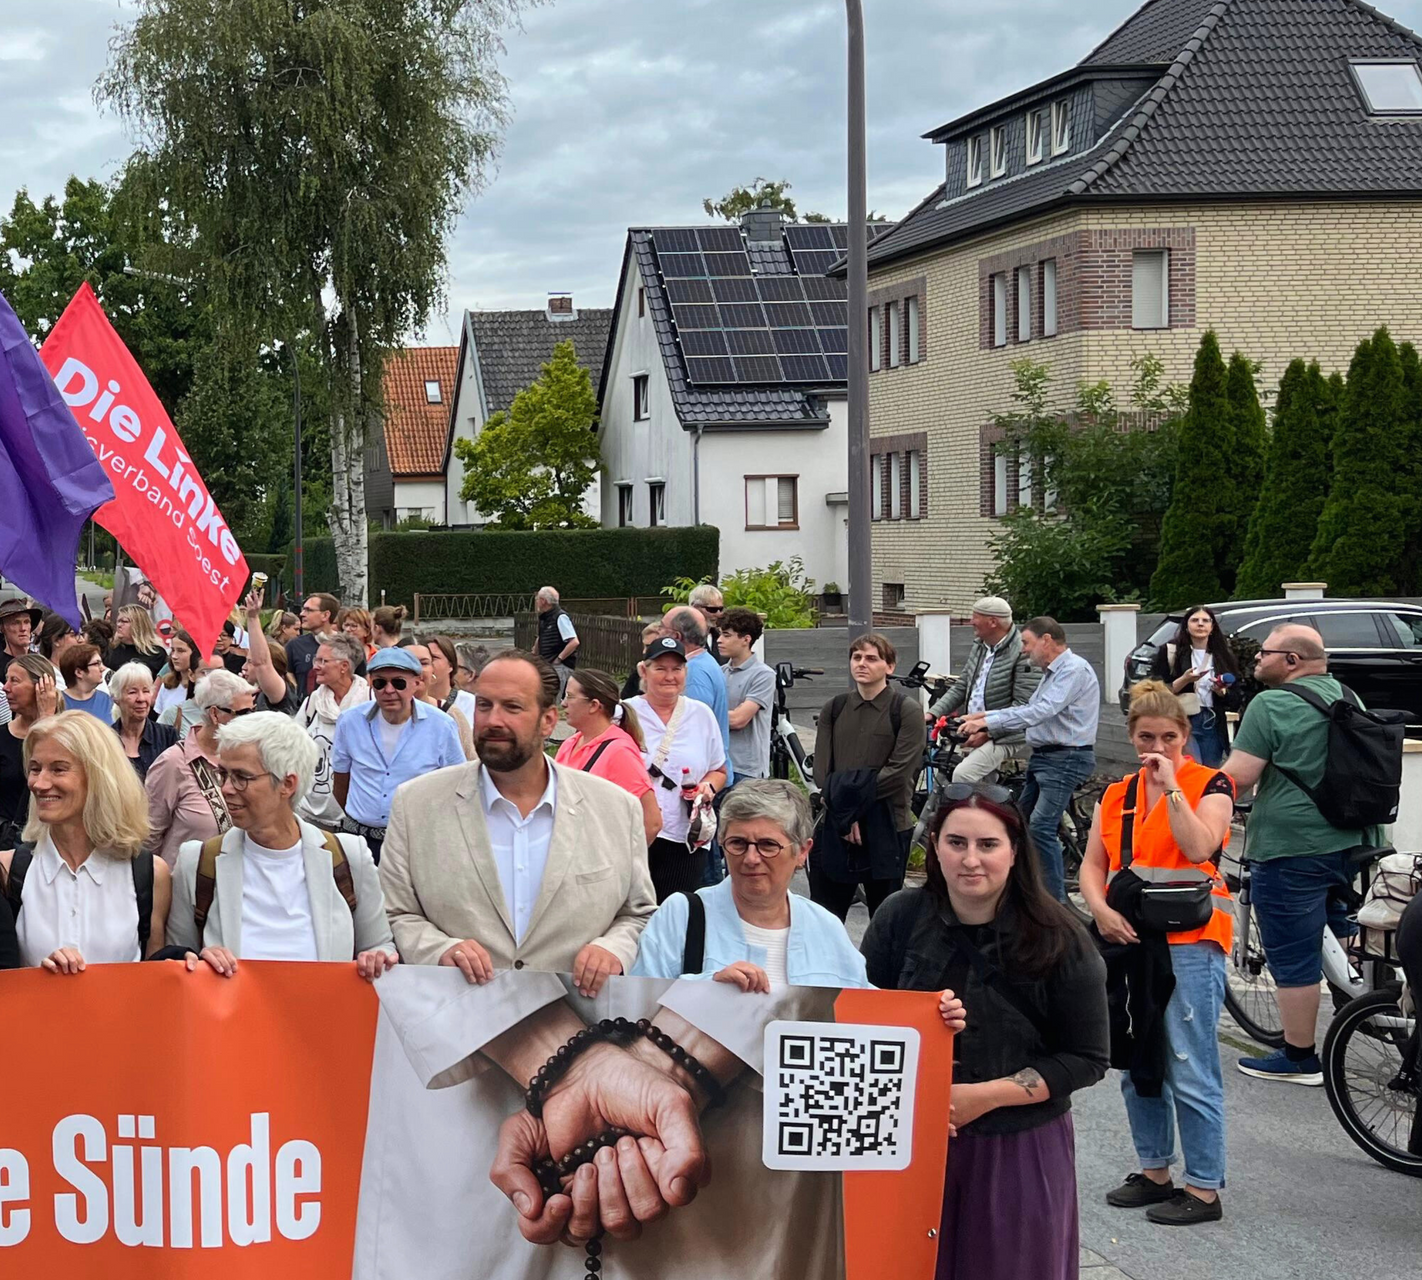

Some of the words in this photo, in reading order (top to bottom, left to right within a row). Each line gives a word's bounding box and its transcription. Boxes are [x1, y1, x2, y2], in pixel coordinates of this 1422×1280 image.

[53, 356, 142, 443] Die
[143, 425, 241, 567] Linke
[186, 526, 231, 595] Soest
[51, 1111, 323, 1250] Sünde
